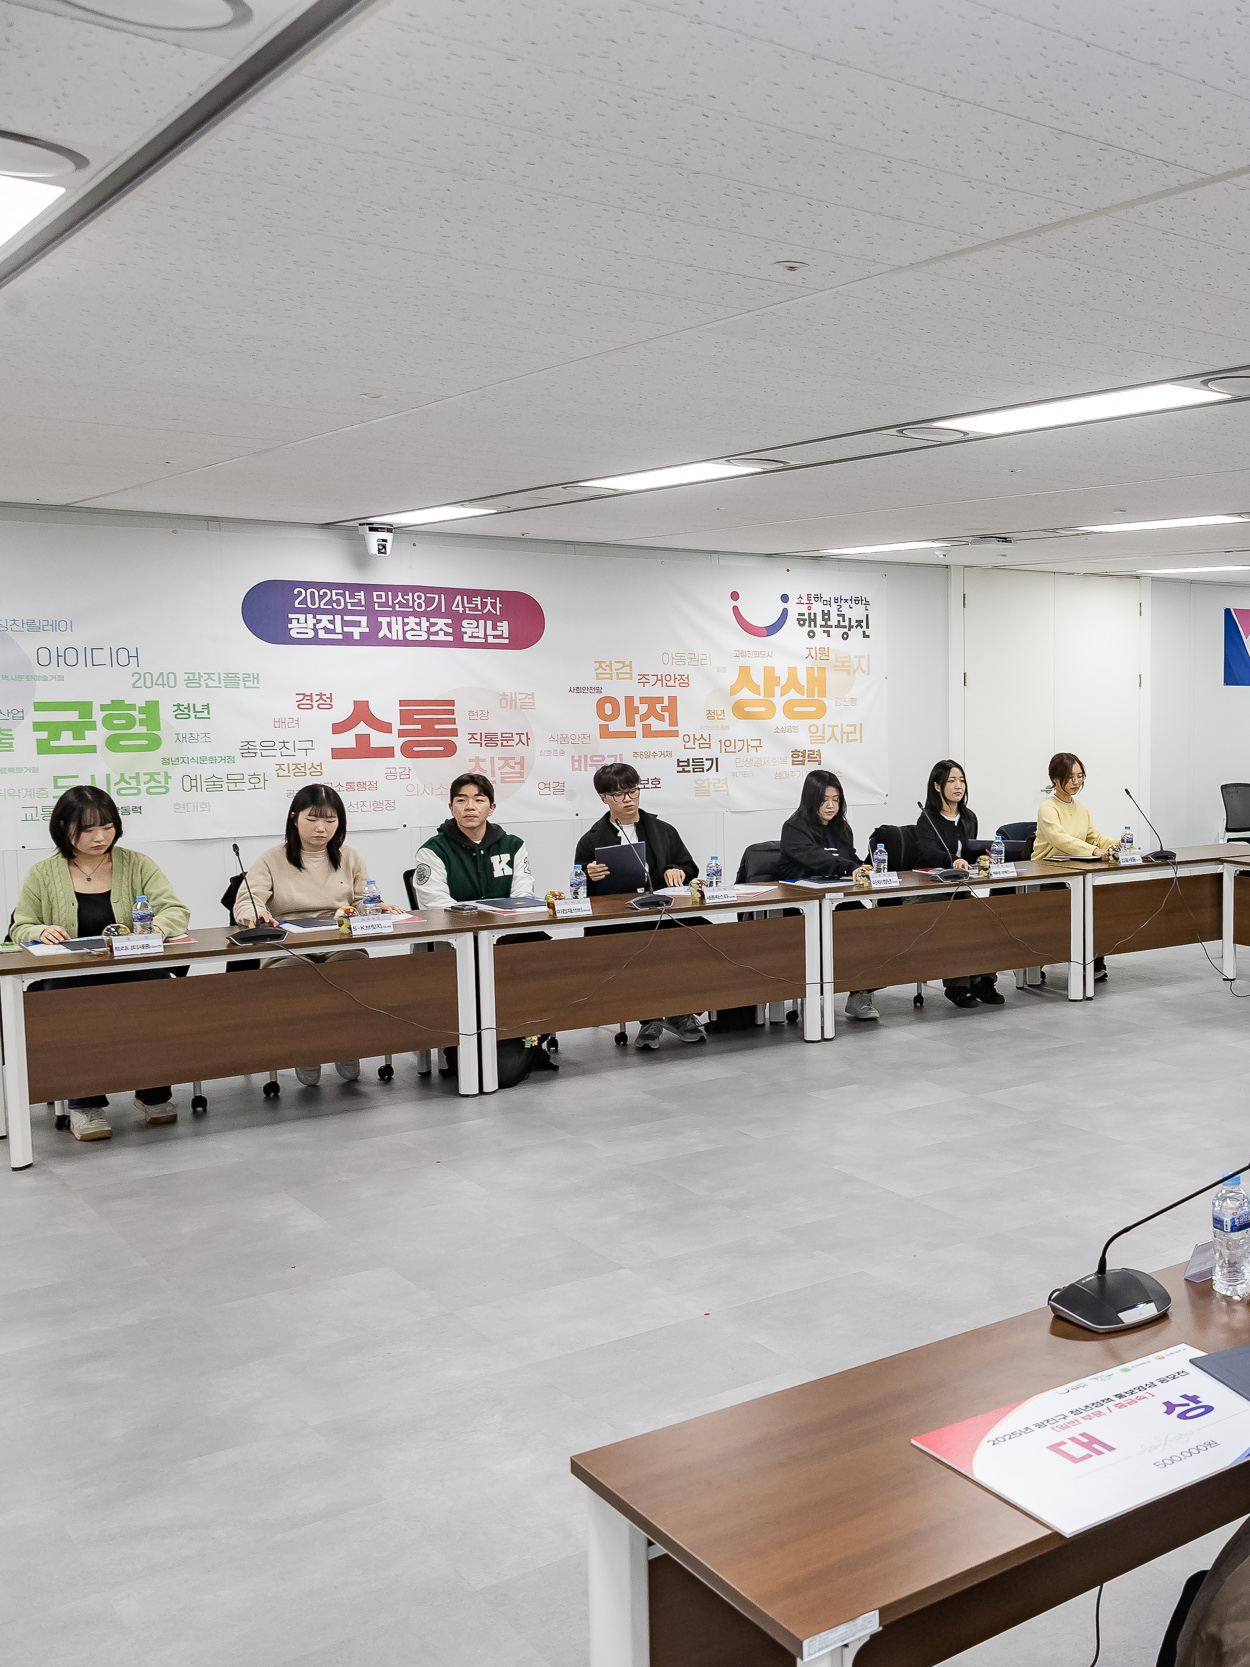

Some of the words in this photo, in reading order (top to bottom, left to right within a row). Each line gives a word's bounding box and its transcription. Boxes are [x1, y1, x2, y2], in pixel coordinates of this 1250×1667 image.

[293, 588, 366, 610] 2025년
[373, 591, 446, 613] 민선8기
[452, 596, 502, 616] 4년차
[796, 593, 831, 611] 소통하며
[834, 595, 870, 612] 발전하는
[287, 613, 370, 640] 광진구
[378, 616, 453, 642] 재창조
[460, 619, 510, 644] 원년
[796, 609, 870, 641] 행복광진
[36, 646, 140, 668] 아이디어
[662, 652, 712, 666] 아동권리
[805, 647, 830, 661] 지원
[594, 660, 633, 680] 점검
[833, 654, 871, 675] 복지
[131, 671, 177, 689] 2040
[183, 671, 260, 689] 광진플랜
[637, 673, 690, 688] 주거안정
[295, 692, 334, 710] 경청
[500, 691, 536, 710] 해결
[730, 666, 827, 720] 상생
[172, 703, 211, 720] 청년
[467, 710, 489, 721] 현장
[596, 695, 679, 739] 안전
[706, 709, 726, 721] 청년
[32, 699, 162, 754] 균형
[273, 717, 300, 729] 배려
[331, 699, 458, 760] 소통
[174, 732, 212, 744] 재창조
[467, 732, 531, 748] 직통문자
[549, 733, 591, 745] 식품안전
[683, 733, 712, 749] 안심
[808, 723, 864, 745] 일자리
[239, 740, 315, 758] 좋은친구
[718, 738, 763, 754] 1인가구
[161, 755, 236, 766] 청년지식문화거점
[676, 757, 719, 774] 보듬기
[791, 749, 822, 766] 협력
[275, 762, 324, 778] 진정성
[384, 766, 412, 780] 공감
[468, 755, 526, 785] 친절
[181, 773, 269, 793] 예술문화
[538, 781, 565, 796] 연결
[694, 777, 730, 798] 활력
[173, 802, 211, 813] 현대화
[347, 800, 396, 813] 선진행정
[490, 853, 513, 878] K
[987, 1425, 1034, 1446] 2025년
[1032, 1412, 1069, 1430] 광진구
[1068, 1397, 1116, 1417] 청년정책
[1113, 1381, 1158, 1400] 홍보영상
[1155, 1369, 1191, 1384] 공모전
[1153, 1439, 1221, 1469] 500,000원
